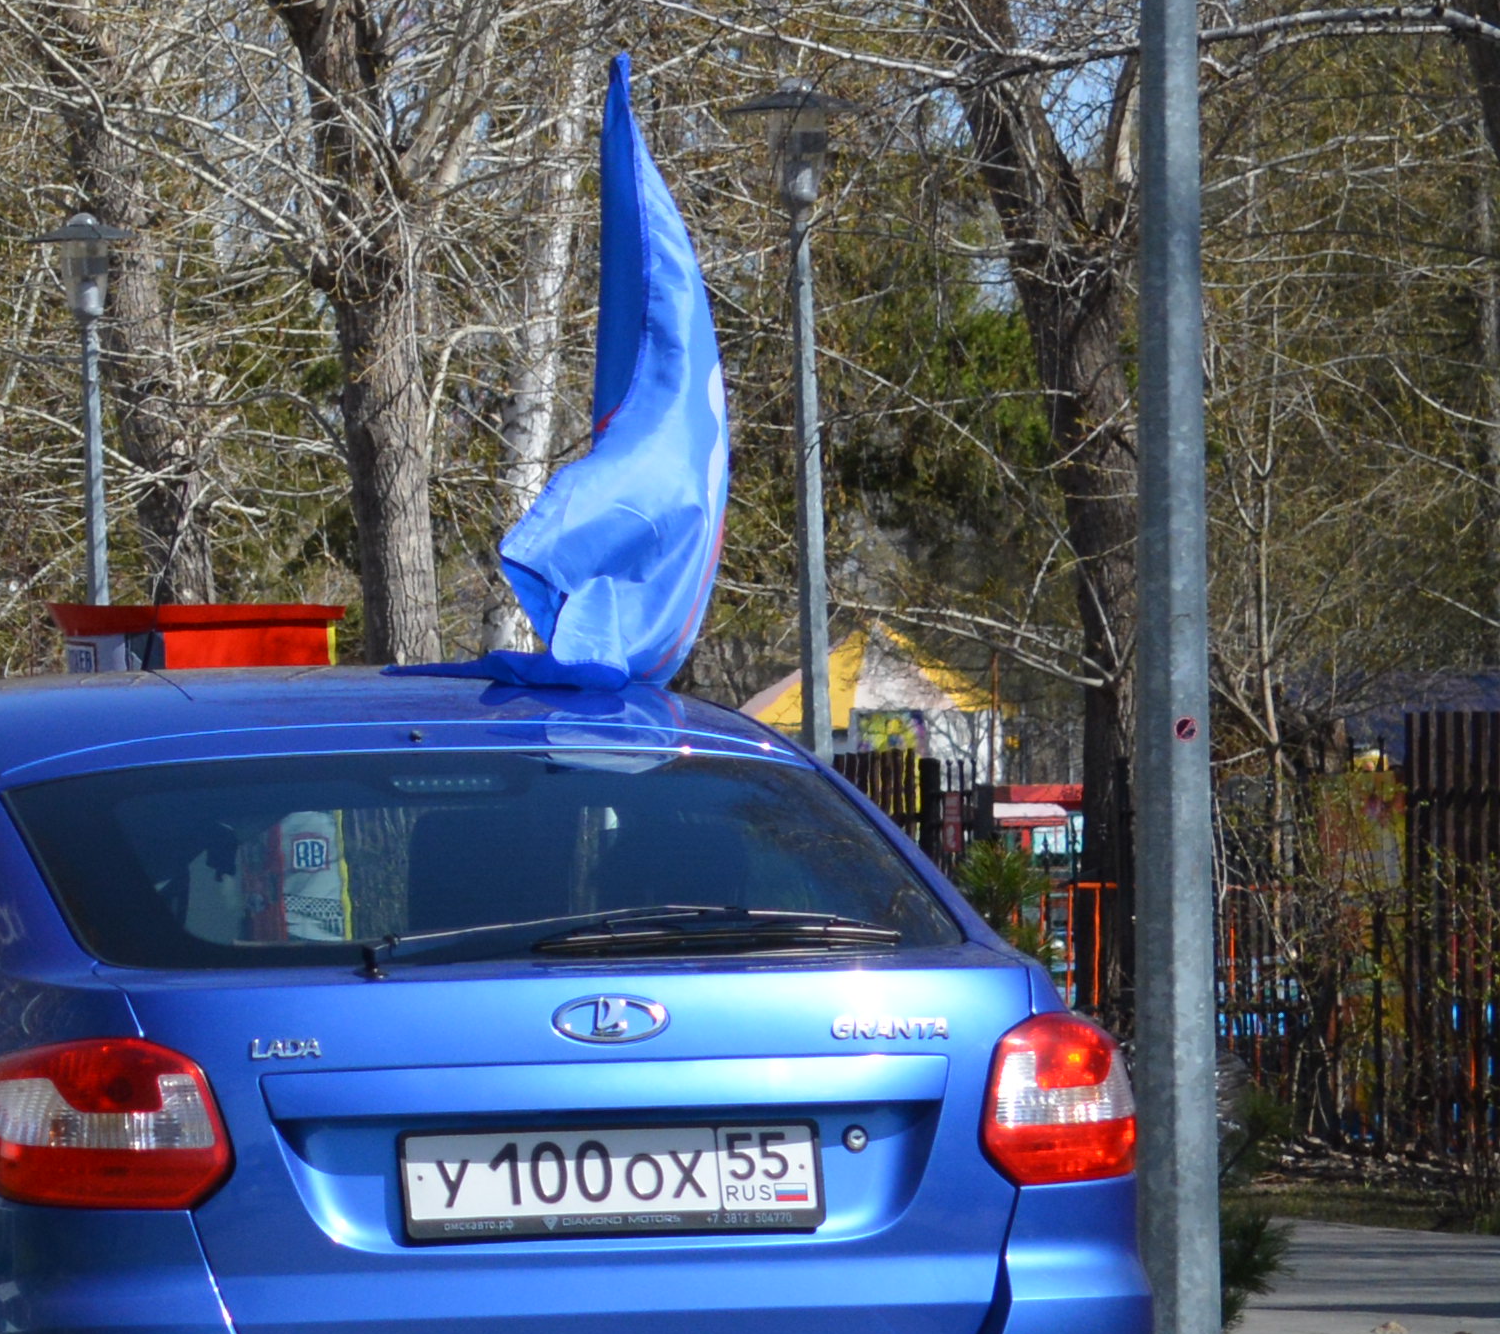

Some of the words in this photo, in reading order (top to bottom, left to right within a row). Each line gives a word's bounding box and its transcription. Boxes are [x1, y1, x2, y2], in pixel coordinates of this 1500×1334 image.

[830, 1016, 950, 1041] GRANTA
[250, 1038, 322, 1060] LADA
[725, 1131, 790, 1182] 55
[725, 1182, 773, 1203] RUS
[561, 1216, 623, 1228] DIAMOND
[627, 1213, 682, 1225] MOTORS
